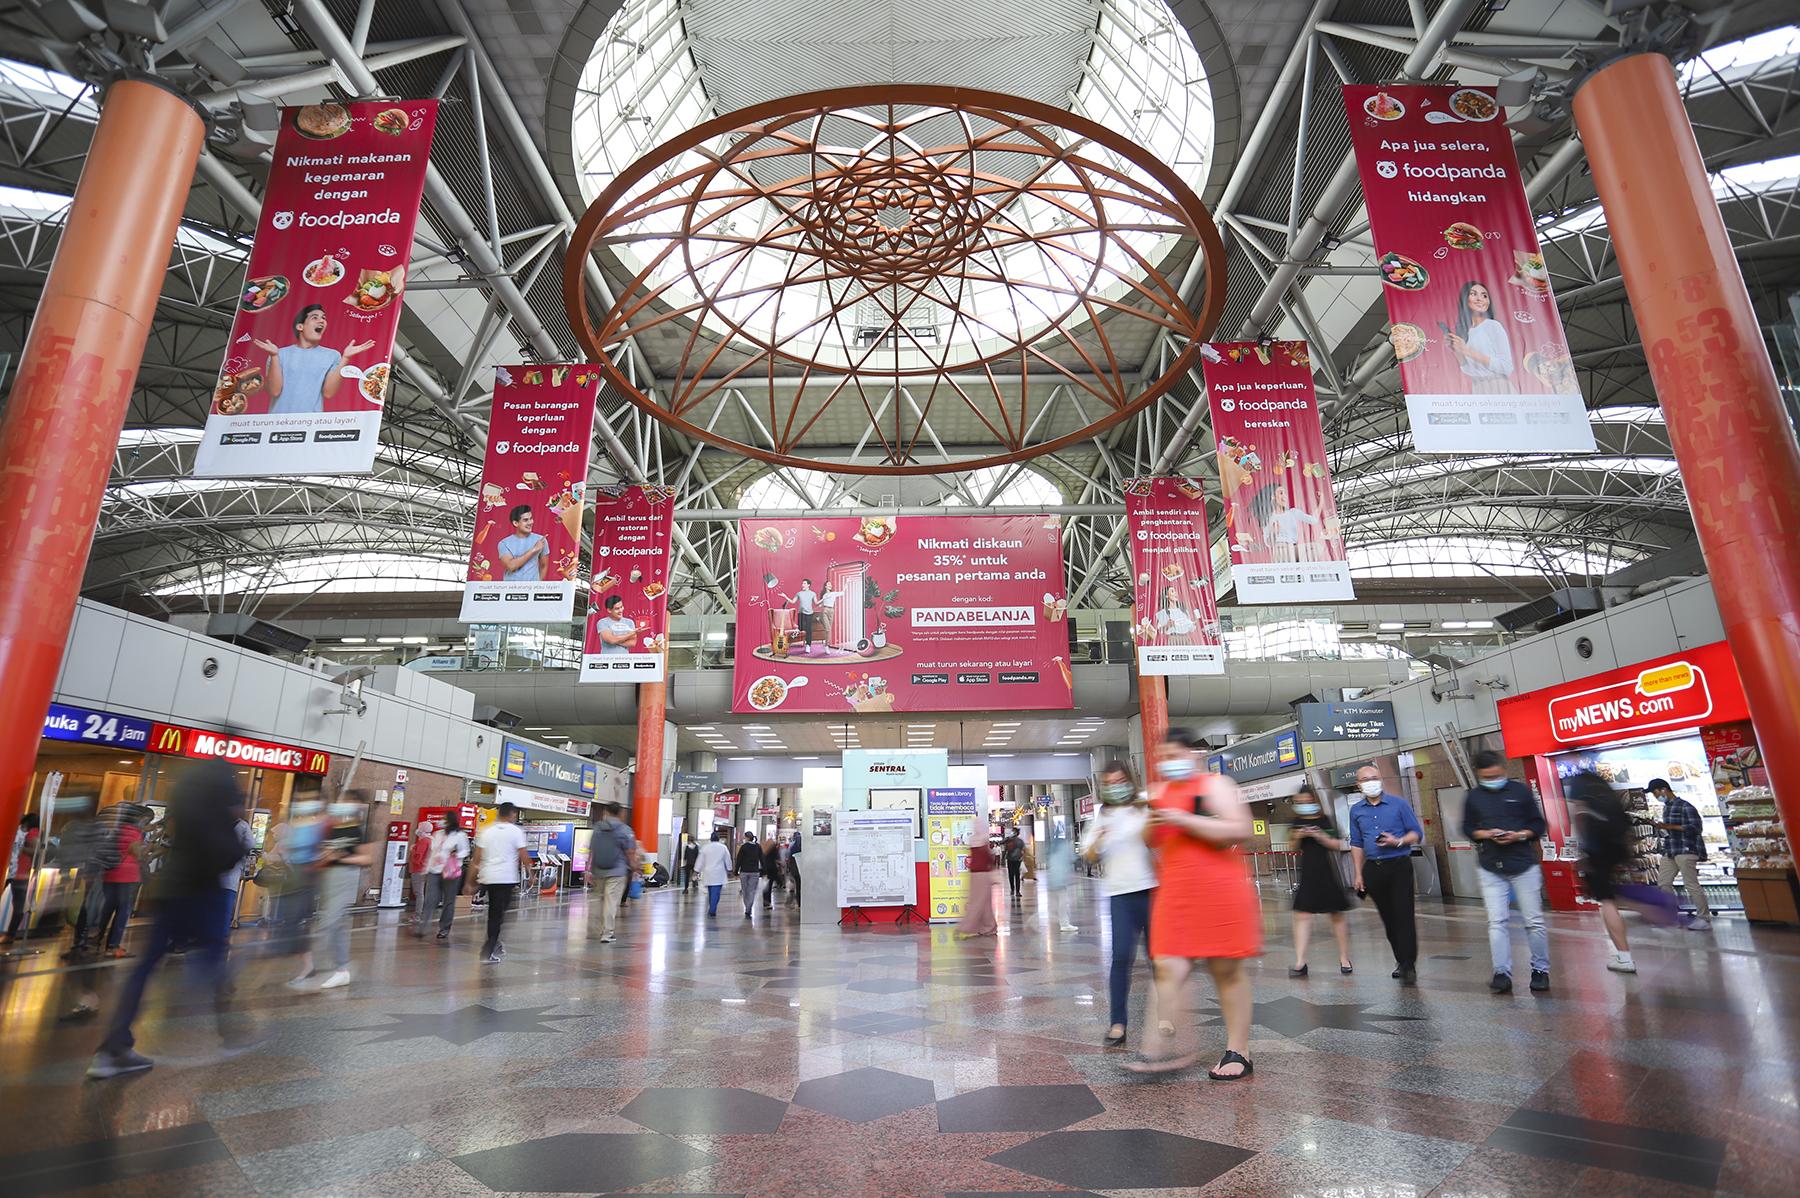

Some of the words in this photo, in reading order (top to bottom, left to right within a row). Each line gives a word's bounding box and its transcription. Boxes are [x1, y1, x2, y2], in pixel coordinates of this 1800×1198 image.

[1380, 139, 1409, 152] Apa
[1413, 140, 1436, 152] jua
[1440, 140, 1490, 152] selera,
[286, 154, 343, 168] Nikmati
[347, 152, 411, 165] makanan
[304, 171, 384, 185] kegemaran
[1403, 163, 1506, 182] foodpanda
[314, 188, 368, 201] dengan
[1408, 191, 1486, 205] hidangkan
[299, 208, 400, 229] foodpanda
[1214, 383, 1234, 392] Apa
[1237, 383, 1252, 392] jua
[1254, 382, 1307, 392] keperluan,
[503, 402, 531, 410] Pesan
[534, 401, 579, 411] barangan
[1238, 398, 1308, 412] foodpanda
[230, 420, 250, 428] muat
[275, 418, 313, 428] sekarang
[314, 417, 331, 425] atau
[333, 416, 356, 426] layari
[517, 413, 565, 423] keperluan
[1244, 420, 1290, 428] bereskan
[521, 426, 557, 436] dengan
[513, 441, 580, 456] foodpanda
[618, 534, 646, 542] dengan
[1149, 531, 1201, 541] foodpanda
[917, 538, 969, 550] Nikmati
[973, 537, 1023, 549] diskaun
[612, 546, 663, 557] foodpanda
[1142, 546, 1172, 554] menjadi
[1173, 546, 1198, 554] pilihan
[970, 554, 1008, 566] untuk
[896, 571, 951, 584] pesanan
[955, 571, 1010, 584] pertama
[1014, 568, 1047, 580] anda
[951, 595, 977, 604] dengan
[916, 609, 1030, 623] PANDABELANJA
[916, 660, 936, 668] muat
[937, 660, 957, 668] turun
[959, 659, 993, 669] sekarang
[994, 659, 1011, 667] atau
[1012, 659, 1033, 668] layari
[1001, 674, 1035, 682] foodpanda.my
[1658, 676, 1672, 684] than
[1673, 672, 1690, 680] news
[1558, 695, 1674, 733] myNEWS.com
[82, 714, 119, 741] 24
[120, 724, 146, 742] jam
[194, 734, 303, 767] McDonald's
[1232, 756, 1248, 772] KTM
[1248, 751, 1277, 768] Komuter
[538, 760, 555, 779] KTM
[869, 765, 906, 773] SENTRAL
[1256, 824, 1263, 832] D
